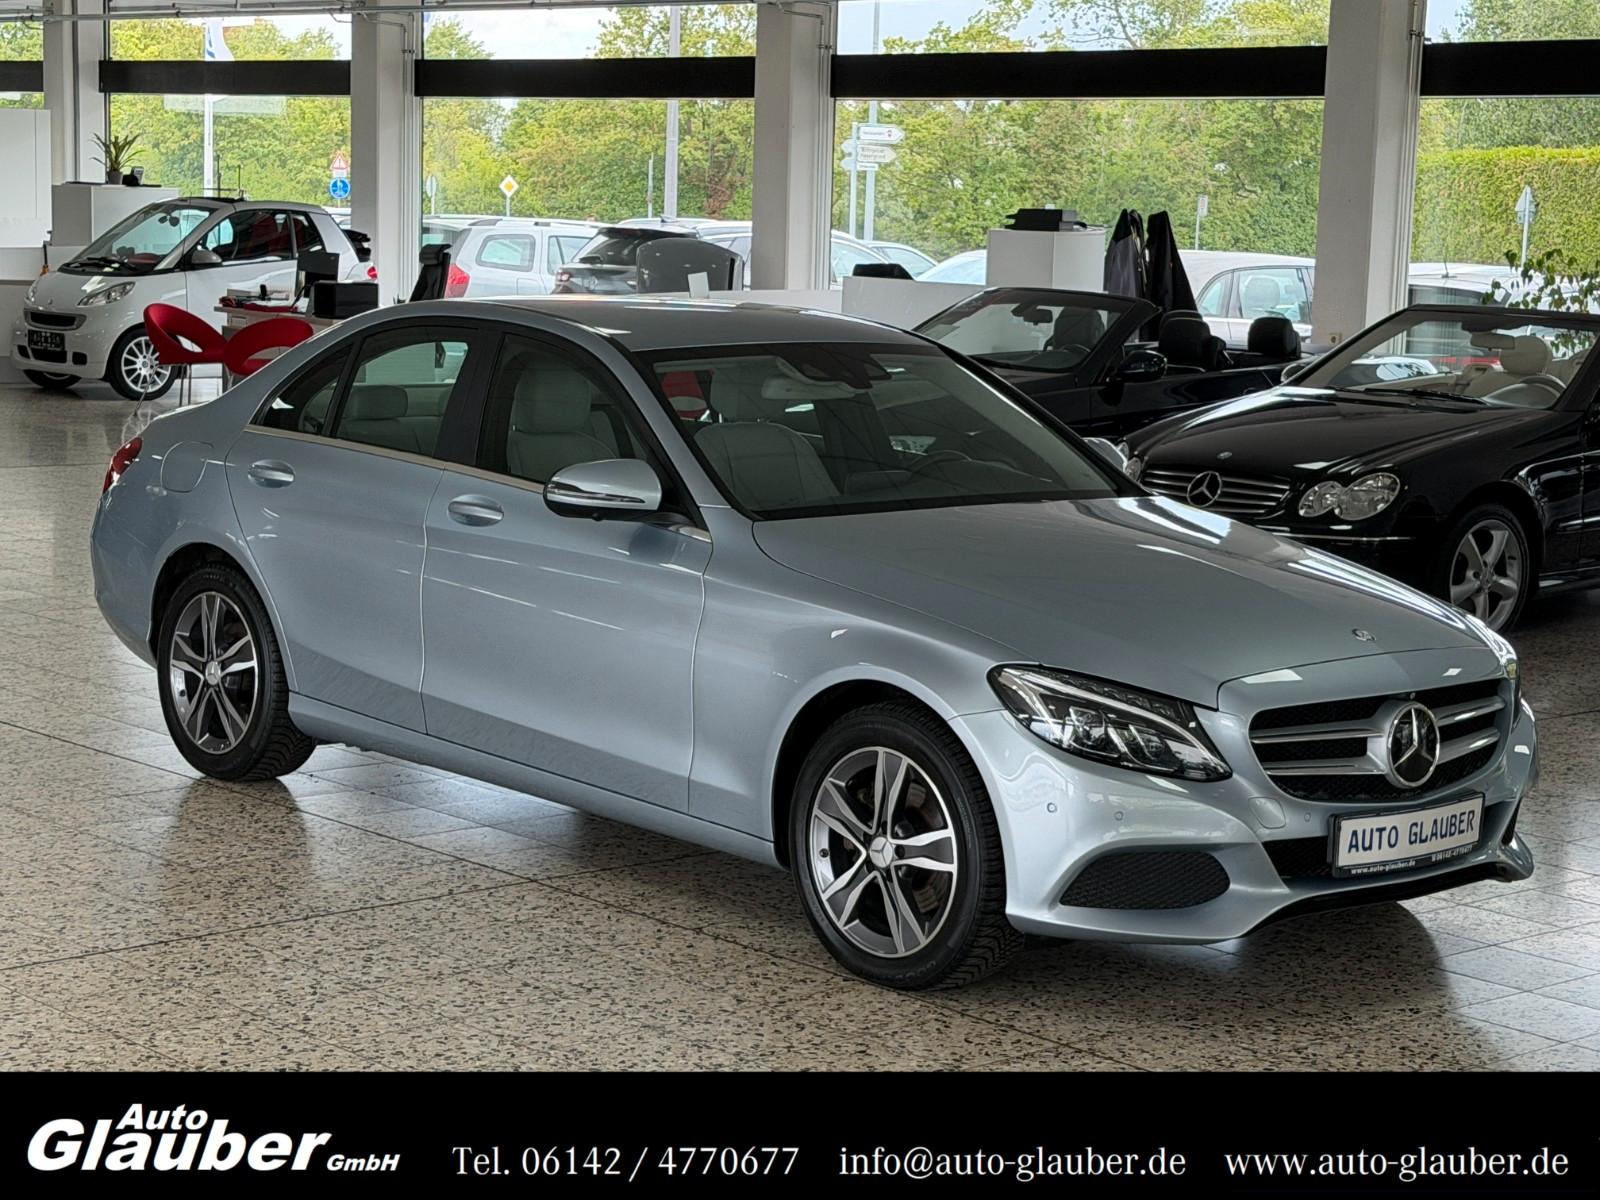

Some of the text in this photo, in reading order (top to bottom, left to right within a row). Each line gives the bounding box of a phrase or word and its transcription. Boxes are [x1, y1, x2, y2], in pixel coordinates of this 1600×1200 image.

[1347, 809, 1476, 854] AUTO GLAUBER
[1351, 859, 1416, 875] www.auto-glauber.de
